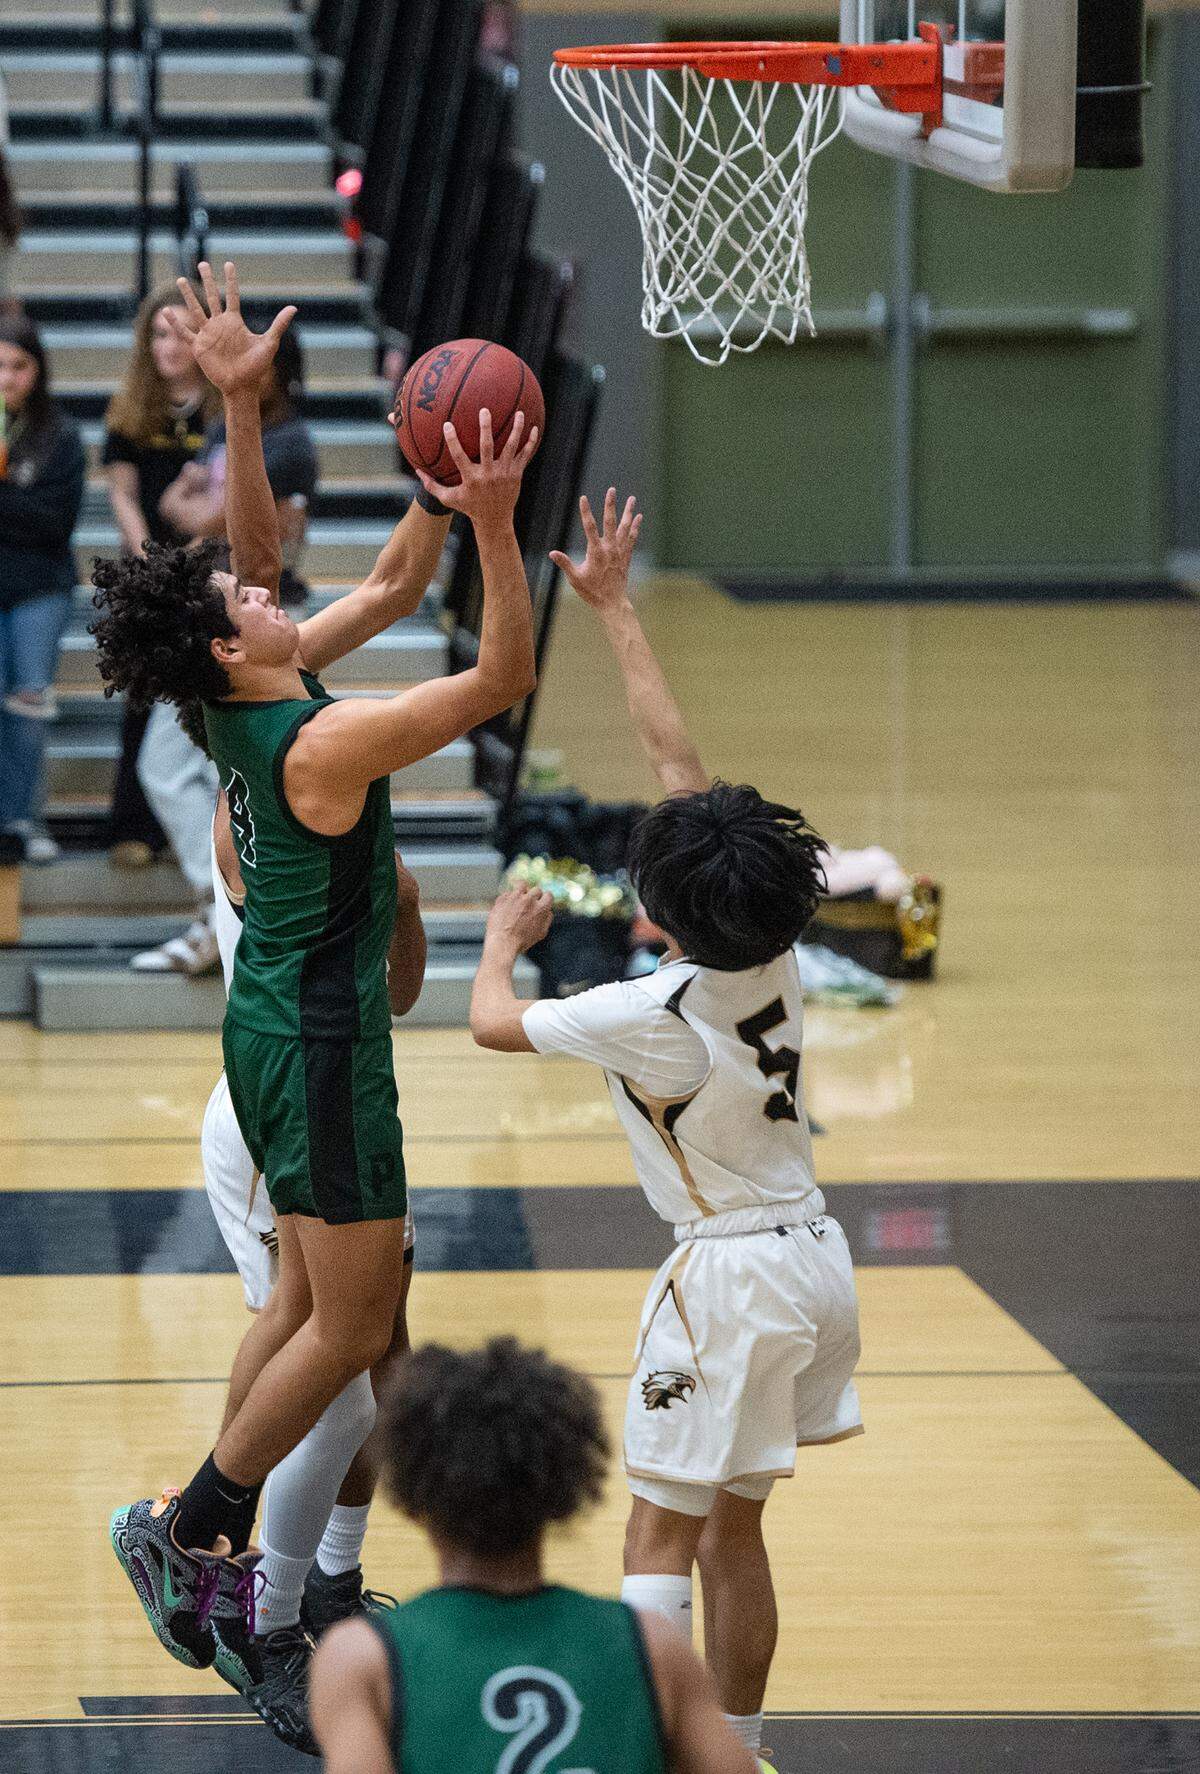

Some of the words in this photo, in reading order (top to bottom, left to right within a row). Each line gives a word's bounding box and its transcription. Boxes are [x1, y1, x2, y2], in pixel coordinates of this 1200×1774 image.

[416, 350, 461, 413] NCAA
[734, 993, 801, 1123] 5
[480, 1665, 584, 1774] 2
